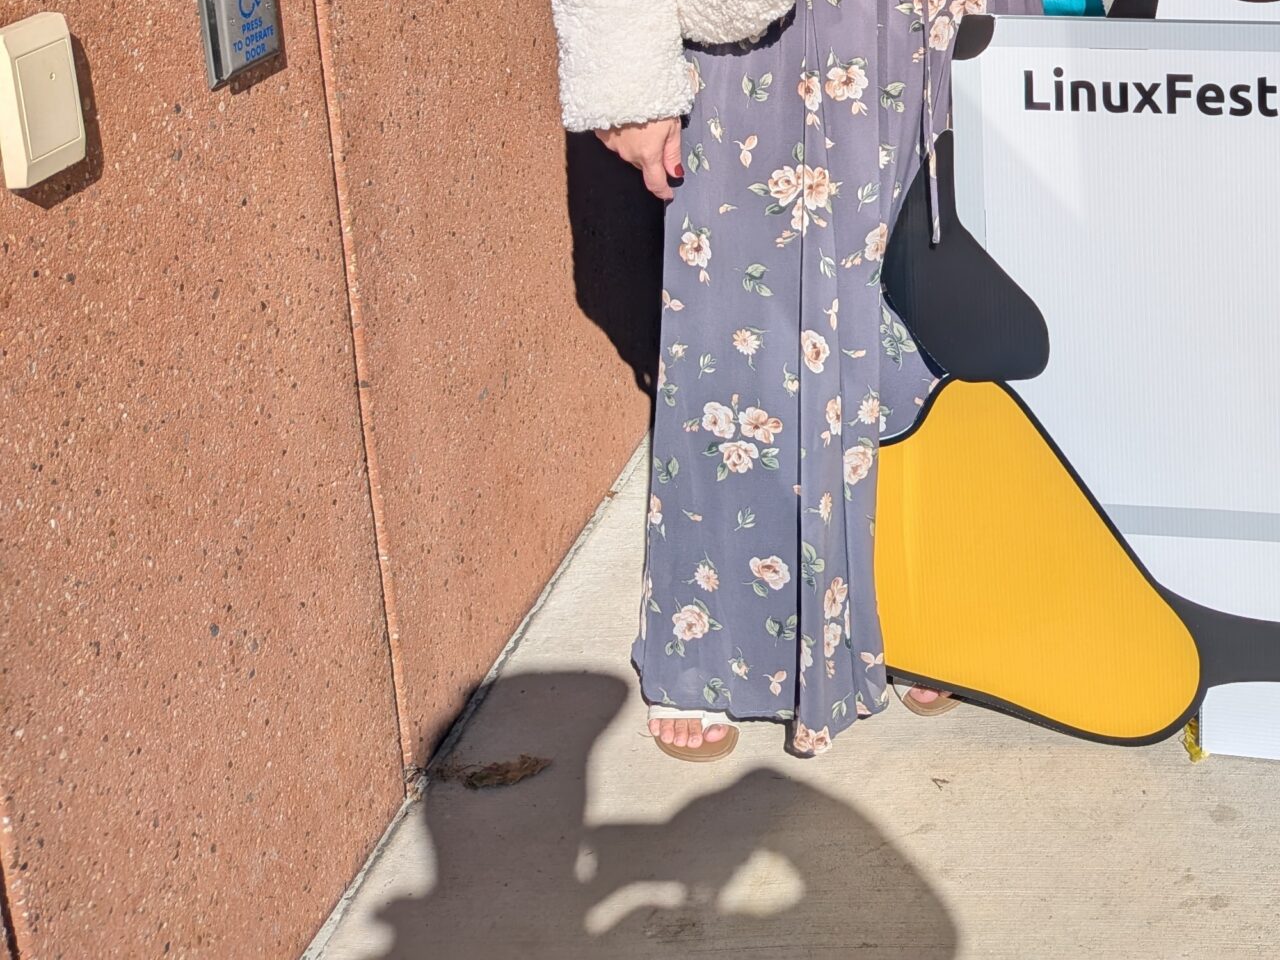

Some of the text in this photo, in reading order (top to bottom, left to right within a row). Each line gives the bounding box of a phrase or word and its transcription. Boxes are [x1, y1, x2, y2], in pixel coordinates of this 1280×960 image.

[242, 17, 263, 34] PRESS
[233, 25, 274, 53] TO OPERATE
[245, 43, 266, 61] DOOR
[1024, 68, 1278, 118] LinuxFest
